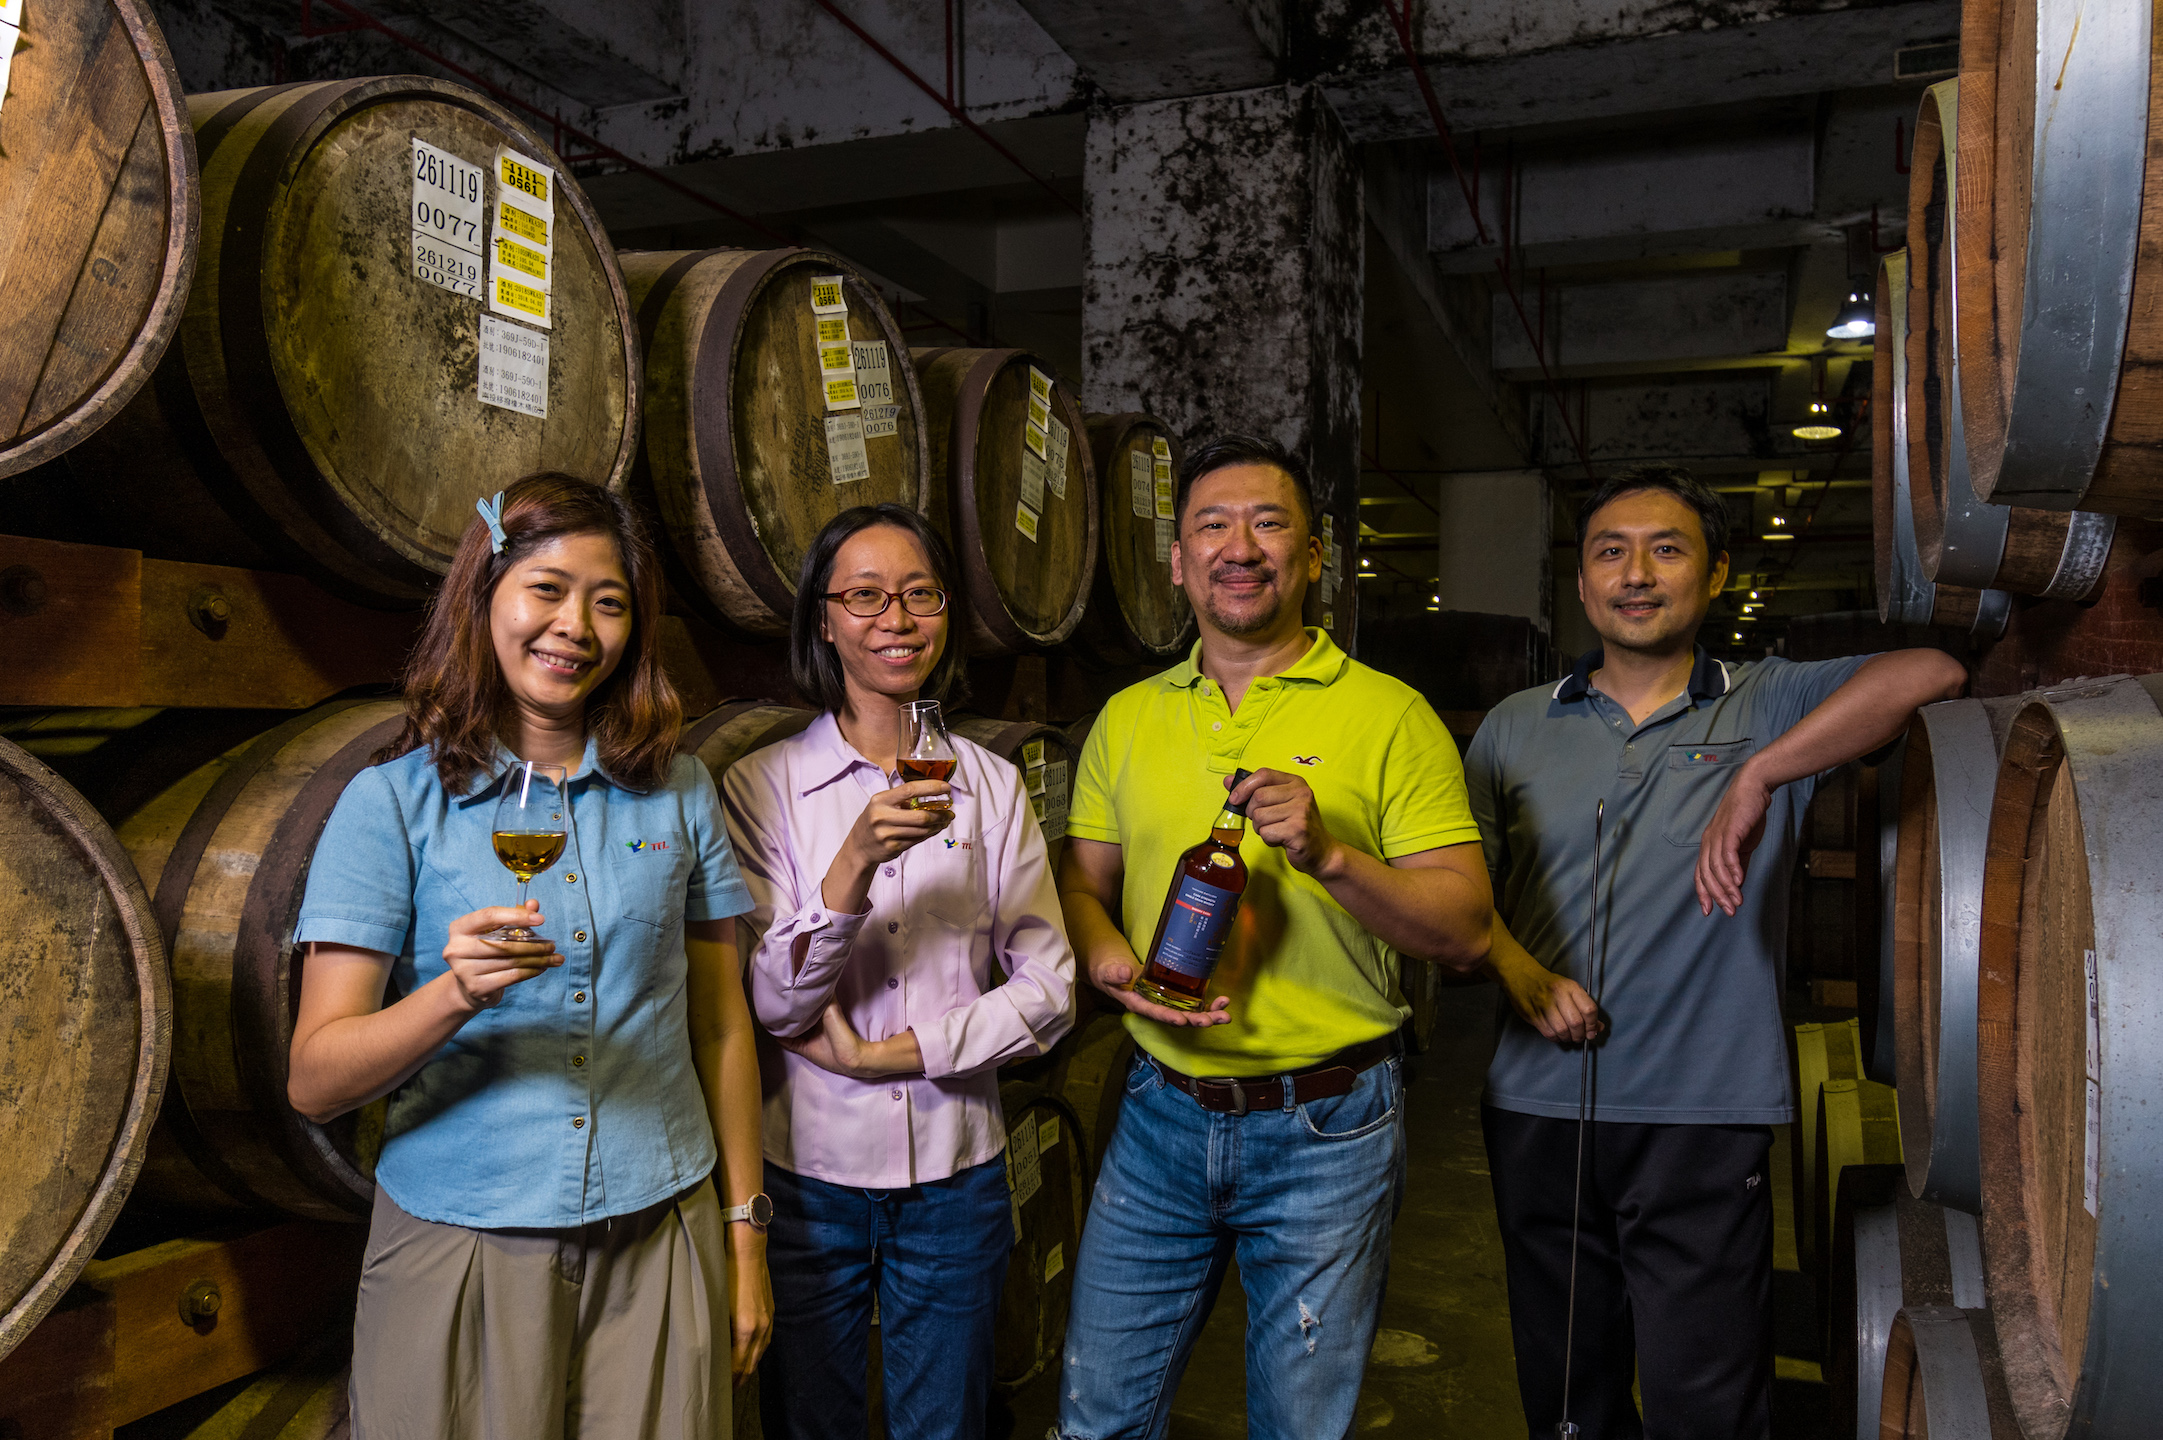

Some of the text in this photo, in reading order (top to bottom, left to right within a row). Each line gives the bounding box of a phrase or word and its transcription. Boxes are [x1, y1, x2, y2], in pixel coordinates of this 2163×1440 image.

[416, 149, 478, 203] 261119
[508, 174, 538, 196] 0561
[417, 202, 477, 242] 0077
[417, 246, 477, 281] 261219
[418, 265, 476, 295] 0077
[855, 346, 886, 370] 261119
[860, 383, 890, 400] 0076
[864, 408, 896, 420] 261219
[866, 422, 894, 433] 0076
[1046, 445, 1064, 468] 0075
[1133, 478, 1150, 492] 0074
[1046, 794, 1066, 810] 0063
[650, 841, 669, 851] TTL
[1012, 1118, 1034, 1154] 261119
[1016, 1146, 1037, 1174] 0051
